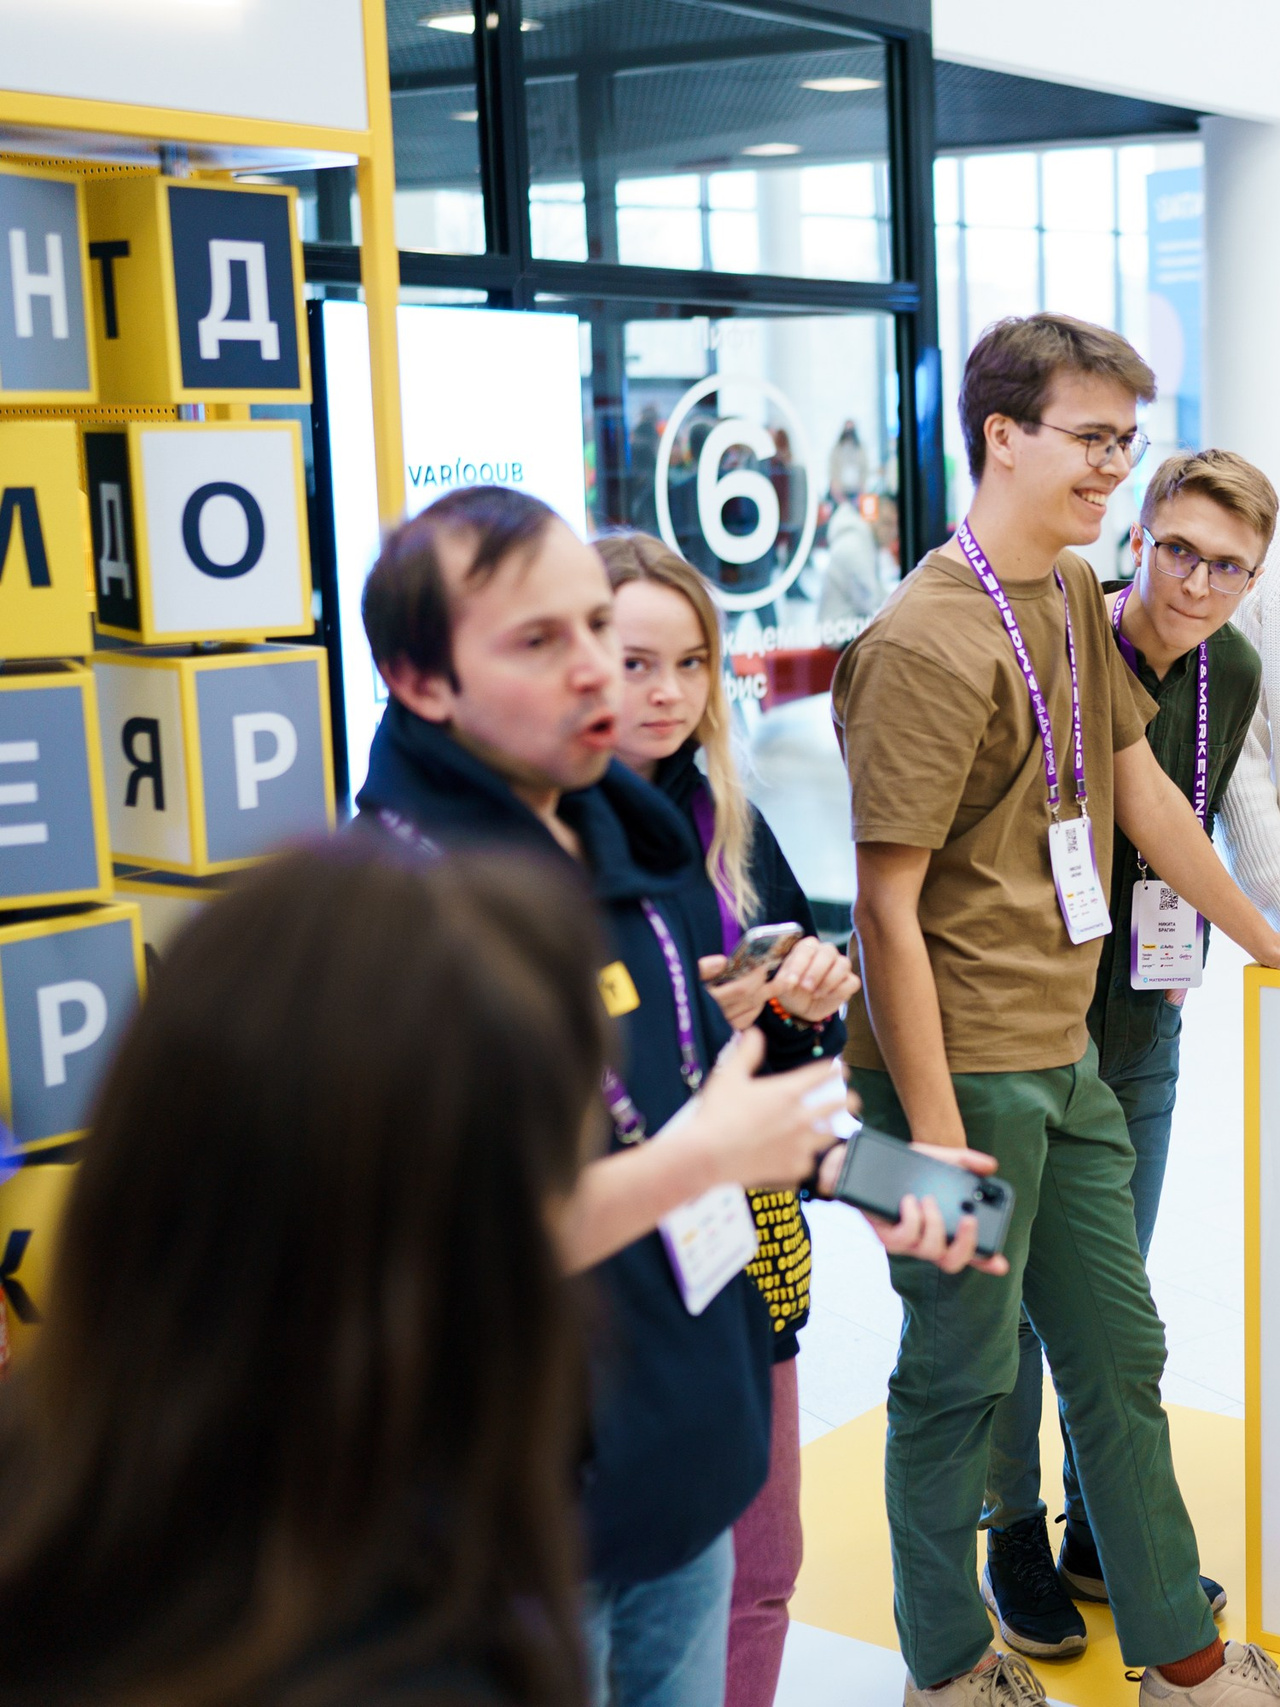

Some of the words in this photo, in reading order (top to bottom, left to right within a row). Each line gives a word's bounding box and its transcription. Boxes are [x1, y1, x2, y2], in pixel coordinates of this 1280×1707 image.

[90, 240, 131, 340] Т
[198, 239, 280, 361] Д
[100, 482, 131, 600] Д
[181, 481, 266, 579] О
[697, 418, 780, 564] 6
[122, 716, 166, 812] Я
[232, 712, 298, 810] Р
[37, 980, 108, 1088] Р
